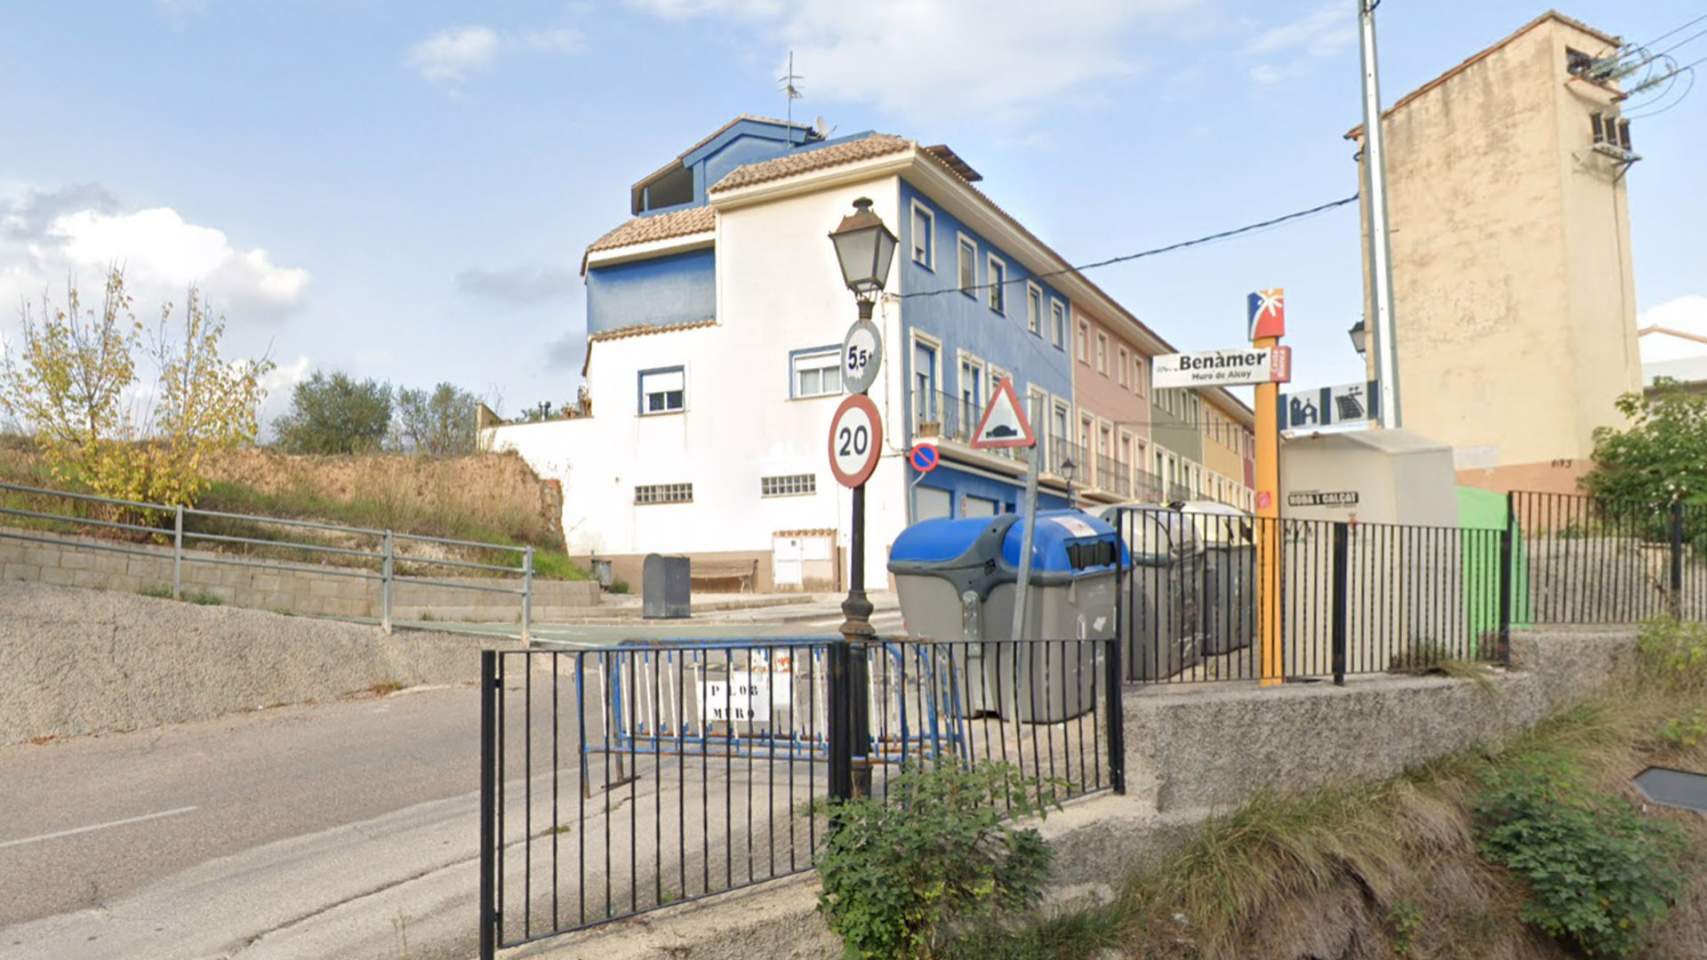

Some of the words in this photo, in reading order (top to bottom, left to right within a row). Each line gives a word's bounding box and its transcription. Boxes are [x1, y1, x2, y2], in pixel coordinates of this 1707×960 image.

[1180, 351, 1267, 371] Benàmer
[1192, 372, 1213, 381] Muro
[1215, 371, 1226, 379] de
[1228, 370, 1252, 380] Alcoy
[839, 425, 868, 457] 20
